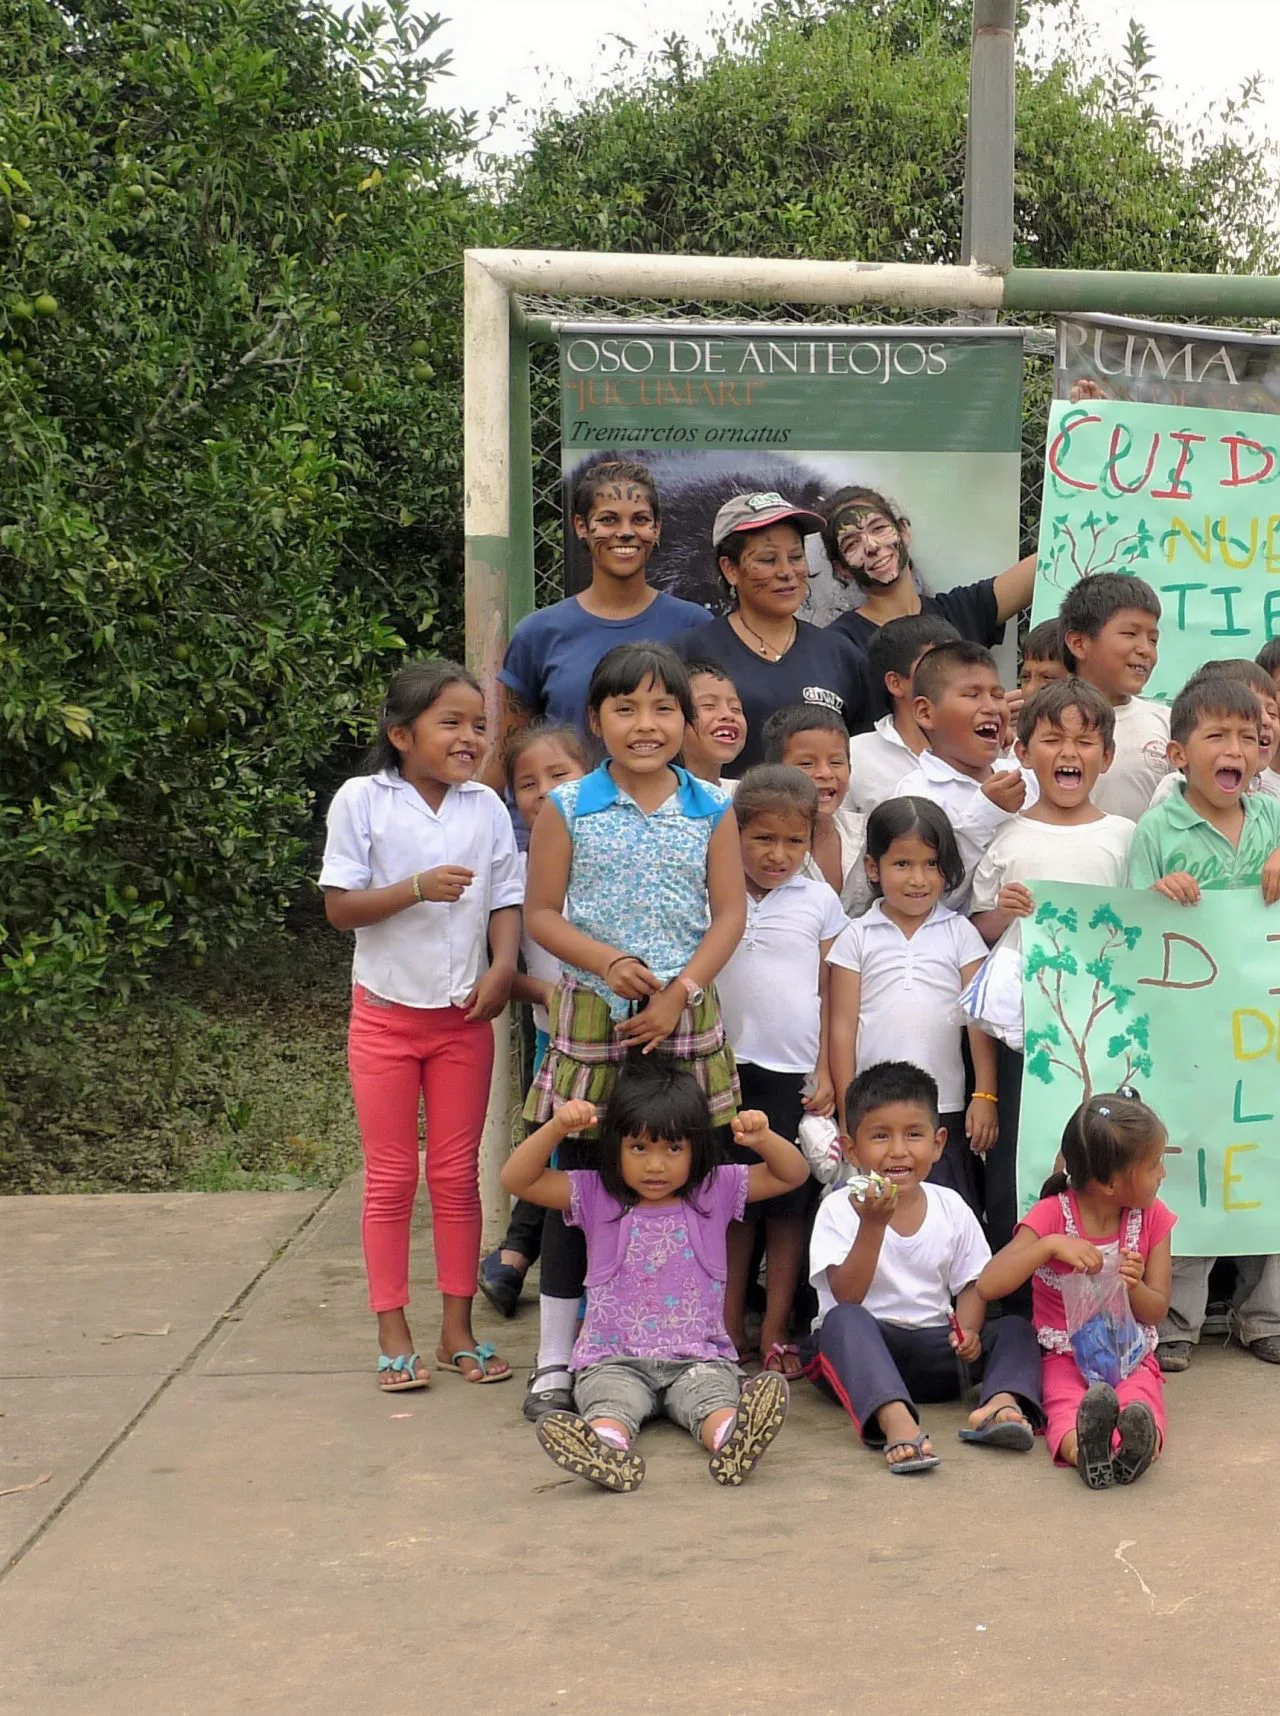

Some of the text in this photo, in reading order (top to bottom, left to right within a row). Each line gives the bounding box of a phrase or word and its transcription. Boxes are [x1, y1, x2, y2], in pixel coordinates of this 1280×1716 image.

[566, 339, 947, 385] OSO DE ANTEOJOS
[1058, 318, 1240, 385] PUMA
[570, 420, 792, 443] Tremarctos ornatus
